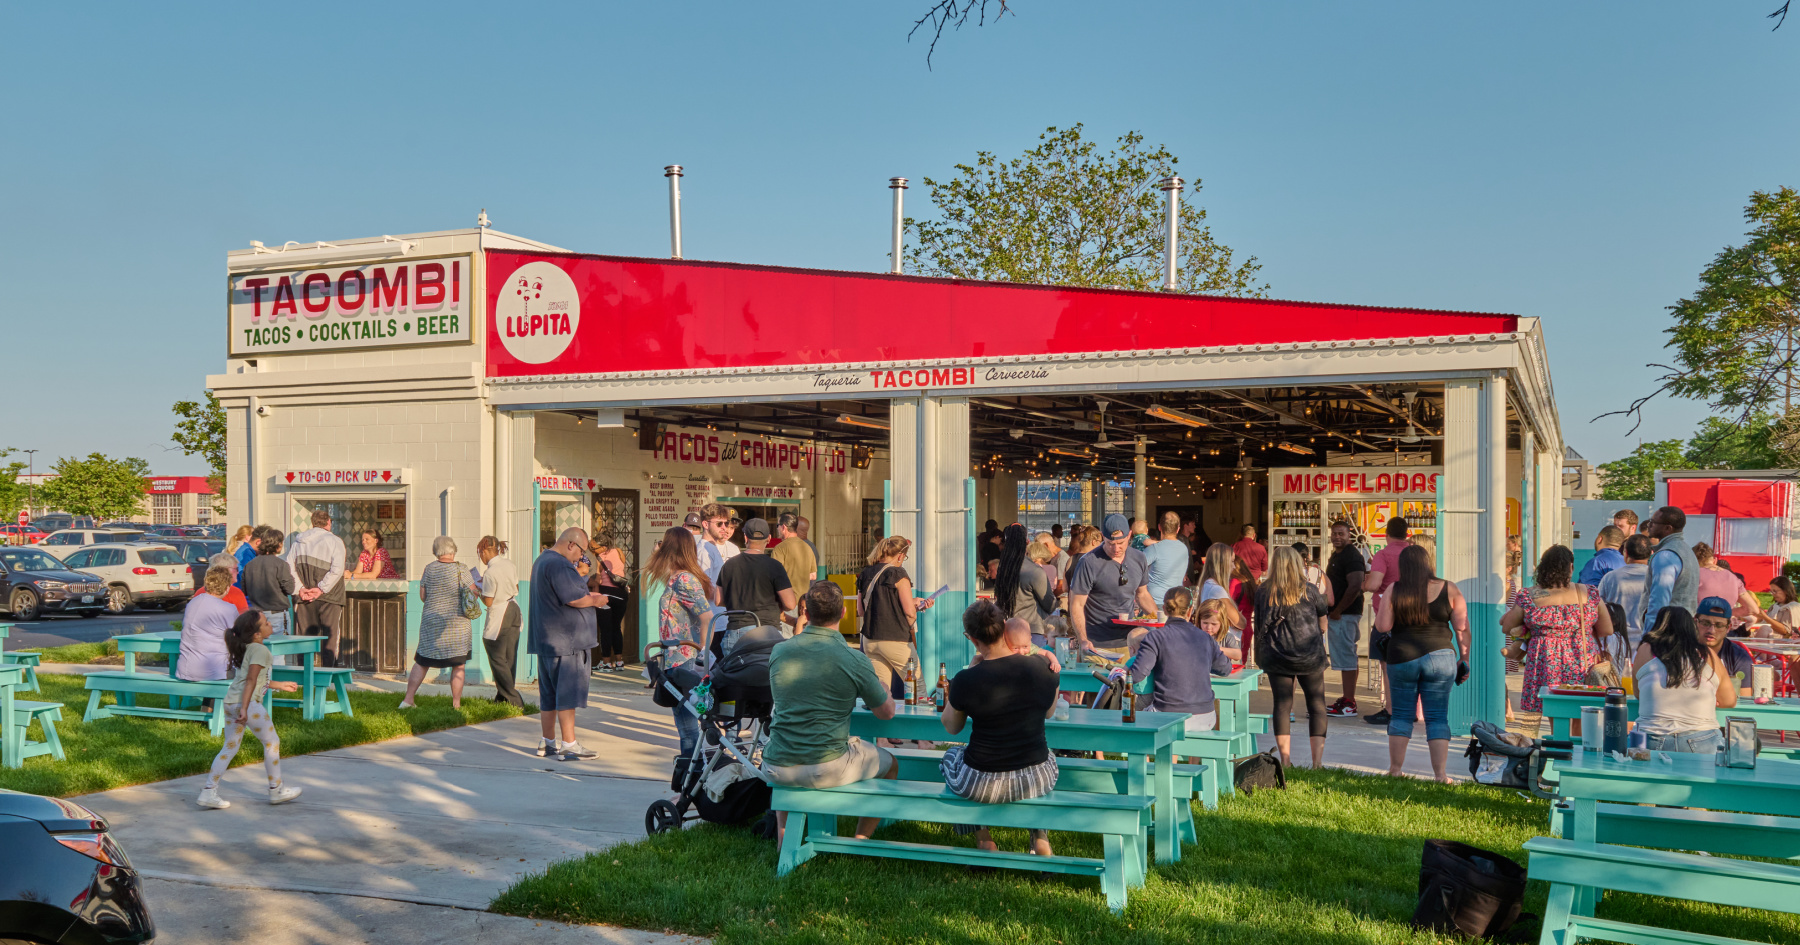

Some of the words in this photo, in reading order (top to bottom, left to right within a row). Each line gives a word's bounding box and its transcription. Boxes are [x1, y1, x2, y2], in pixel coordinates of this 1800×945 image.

[243, 261, 460, 322] TACOMBI
[244, 326, 291, 346] TACOS
[309, 319, 397, 342] COCKTAILS
[417, 315, 459, 335] BEER
[506, 313, 571, 338] LUPITA
[813, 373, 861, 391] Taqueria
[870, 367, 975, 388] TACOMBI
[985, 366, 1049, 381] Cerveceria
[654, 431, 719, 464] ACOS
[722, 440, 738, 461] del
[741, 439, 800, 470] CAMPO
[299, 471, 331, 483] TO-GO
[335, 470, 360, 483] PICK
[363, 470, 378, 482] UP
[534, 476, 559, 489] RDER
[562, 477, 583, 491] HERE
[1283, 472, 1438, 494] MICHELADAS
[751, 487, 764, 497] PICK
[765, 487, 773, 498] UP
[773, 488, 787, 498] HERE
